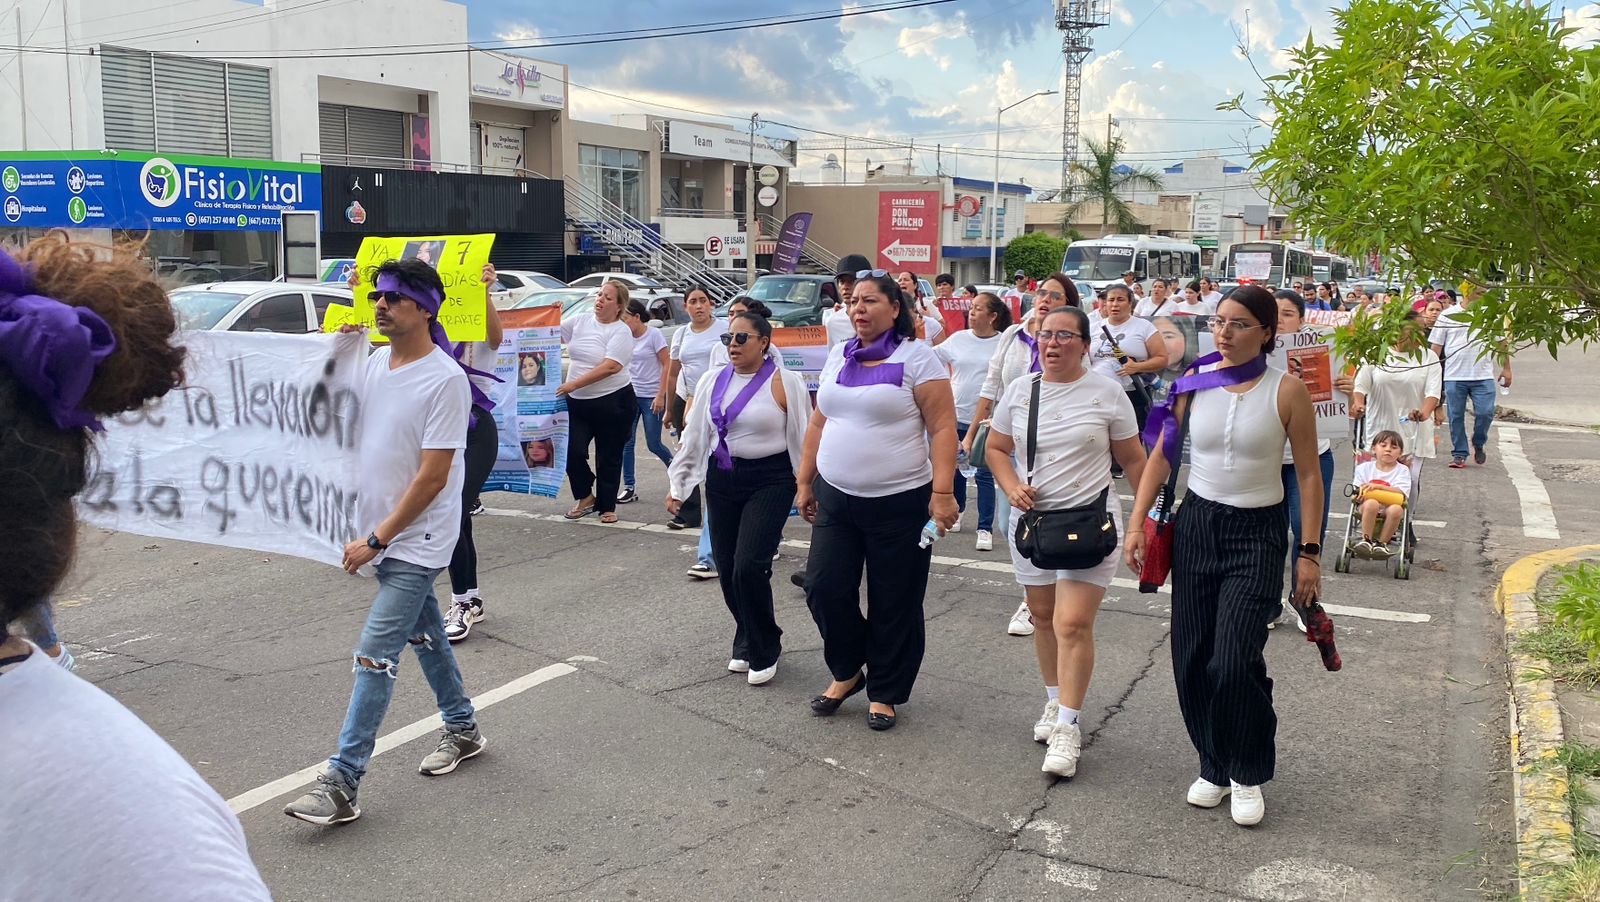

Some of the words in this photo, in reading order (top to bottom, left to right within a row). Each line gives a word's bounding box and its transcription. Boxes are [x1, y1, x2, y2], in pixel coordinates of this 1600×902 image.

[693, 135, 713, 148] Team
[185, 166, 302, 204] FisioVital
[213, 201, 222, 209] de
[892, 198, 925, 206] CARNICERÍA
[892, 208, 908, 217] DON
[198, 215, 212, 224] (667)
[212, 216, 221, 224] 257
[248, 216, 261, 225] (667)
[892, 218, 924, 227] PONCHO
[724, 236, 730, 245] SE
[731, 236, 745, 245] USARA
[370, 243, 390, 260] YA
[457, 240, 472, 265] 7
[729, 247, 741, 256] GRUA
[1100, 247, 1133, 257] HUIZACHES
[449, 297, 463, 307] DE
[1293, 330, 1327, 347] TODOS
